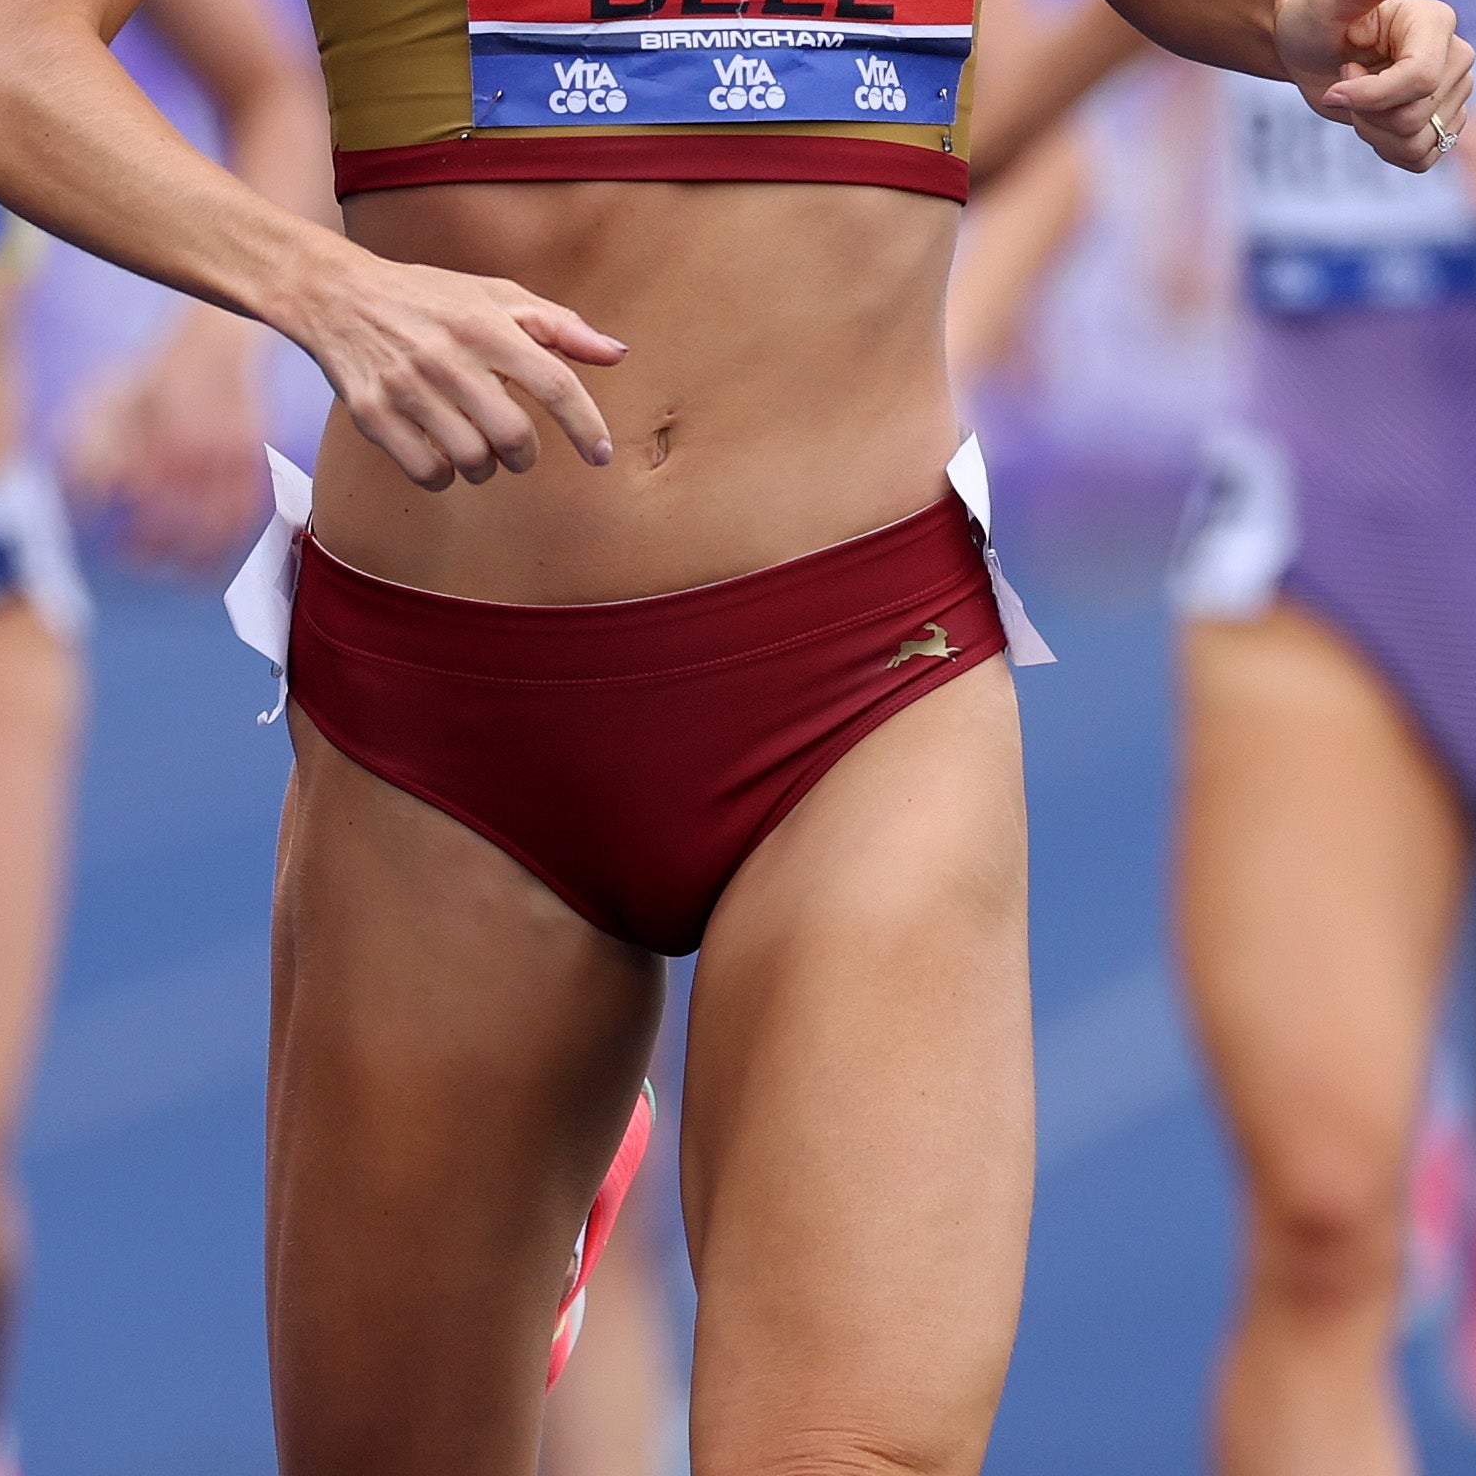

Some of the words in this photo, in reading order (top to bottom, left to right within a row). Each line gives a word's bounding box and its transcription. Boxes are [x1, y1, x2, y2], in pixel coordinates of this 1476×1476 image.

[640, 30, 846, 50] BIRMINGHAM
[553, 57, 620, 90] VITA
[712, 53, 778, 87] VITA
[854, 54, 902, 88] VITA
[548, 89, 628, 114] COCO
[708, 85, 787, 111] COCO
[854, 85, 907, 112] COCO
